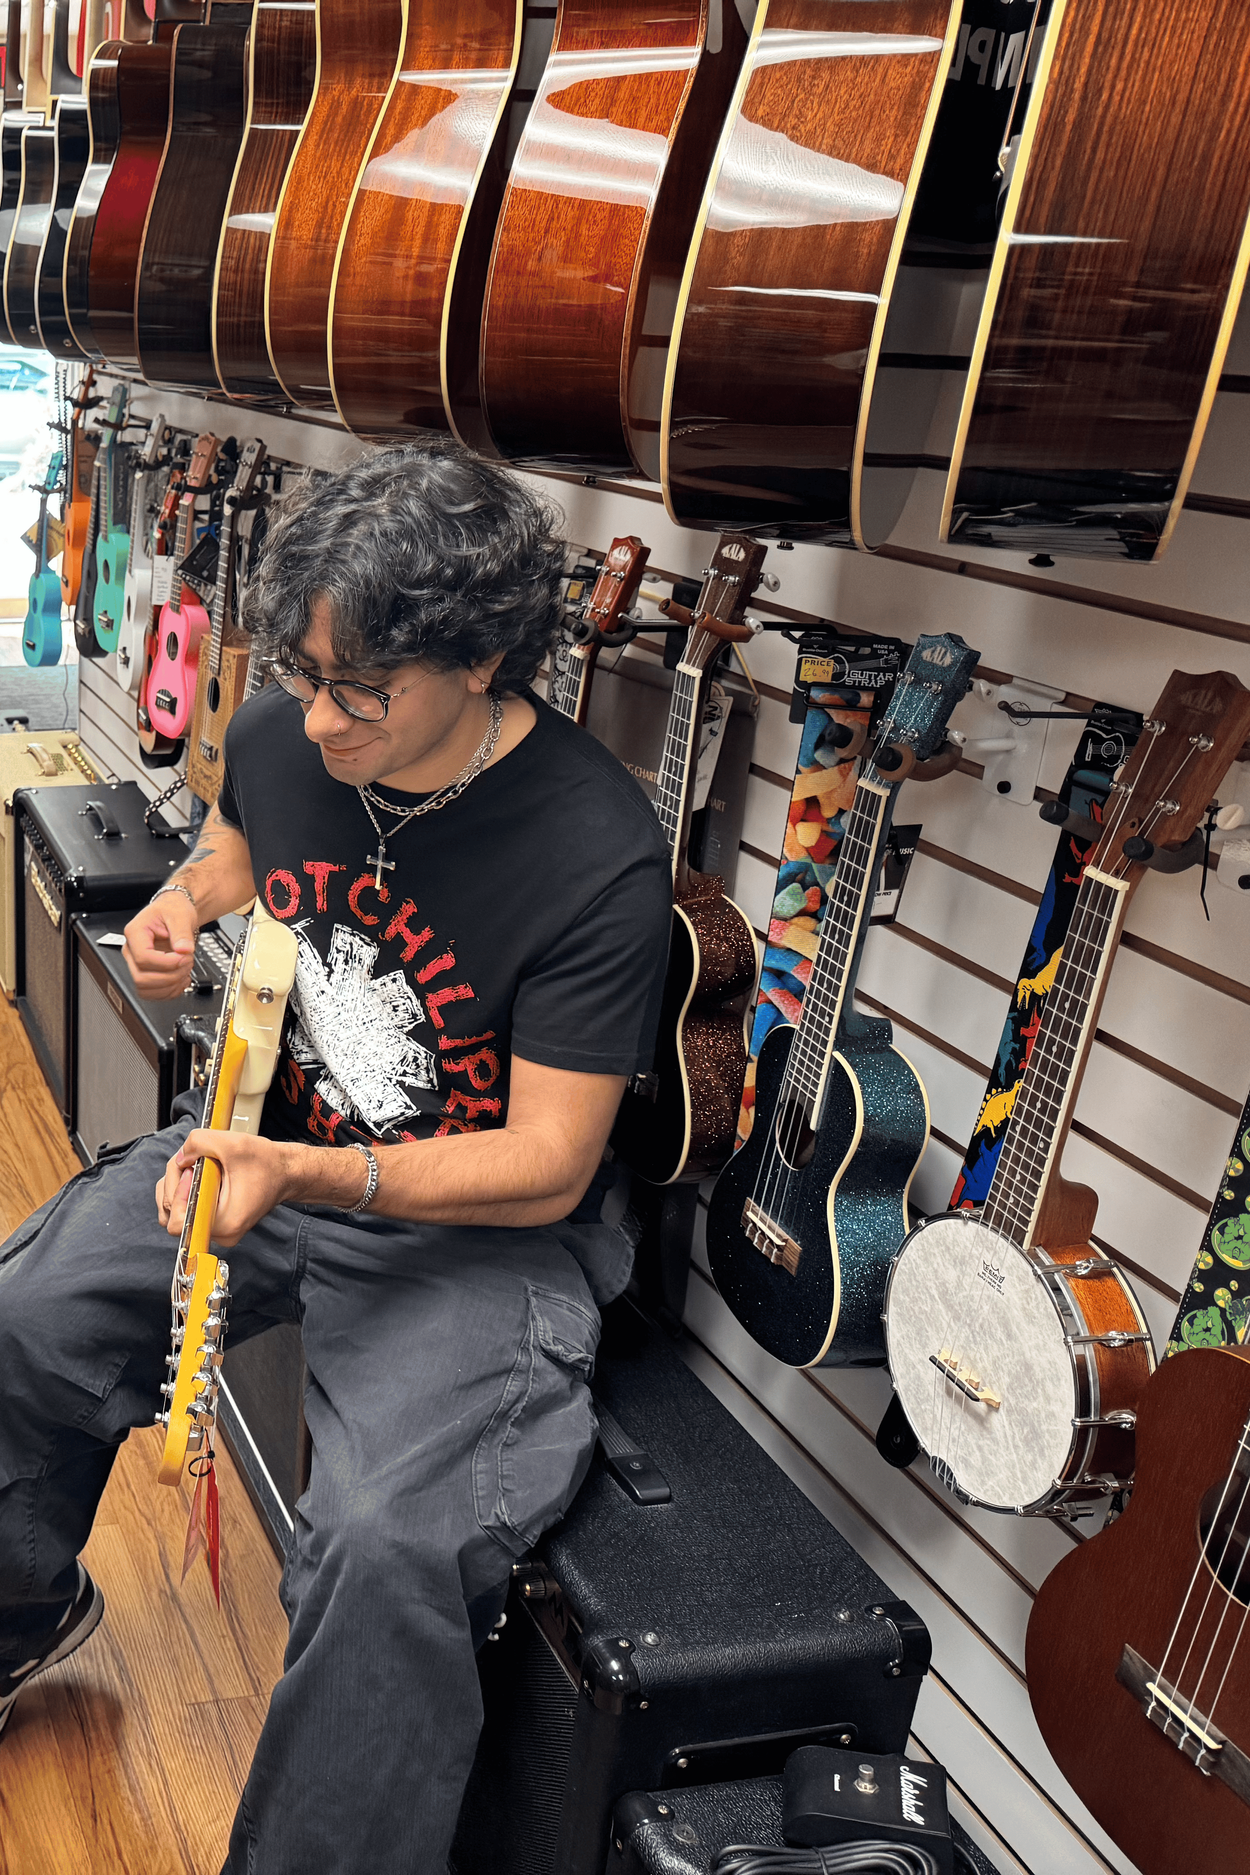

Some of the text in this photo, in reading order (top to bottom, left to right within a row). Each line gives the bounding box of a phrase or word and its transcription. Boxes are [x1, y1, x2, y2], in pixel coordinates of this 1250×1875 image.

[804, 659, 832, 667] PRICE
[850, 671, 893, 681] GUITAR
[845, 678, 886, 688] STRAP
[899, 1765, 928, 1826] Marshall
